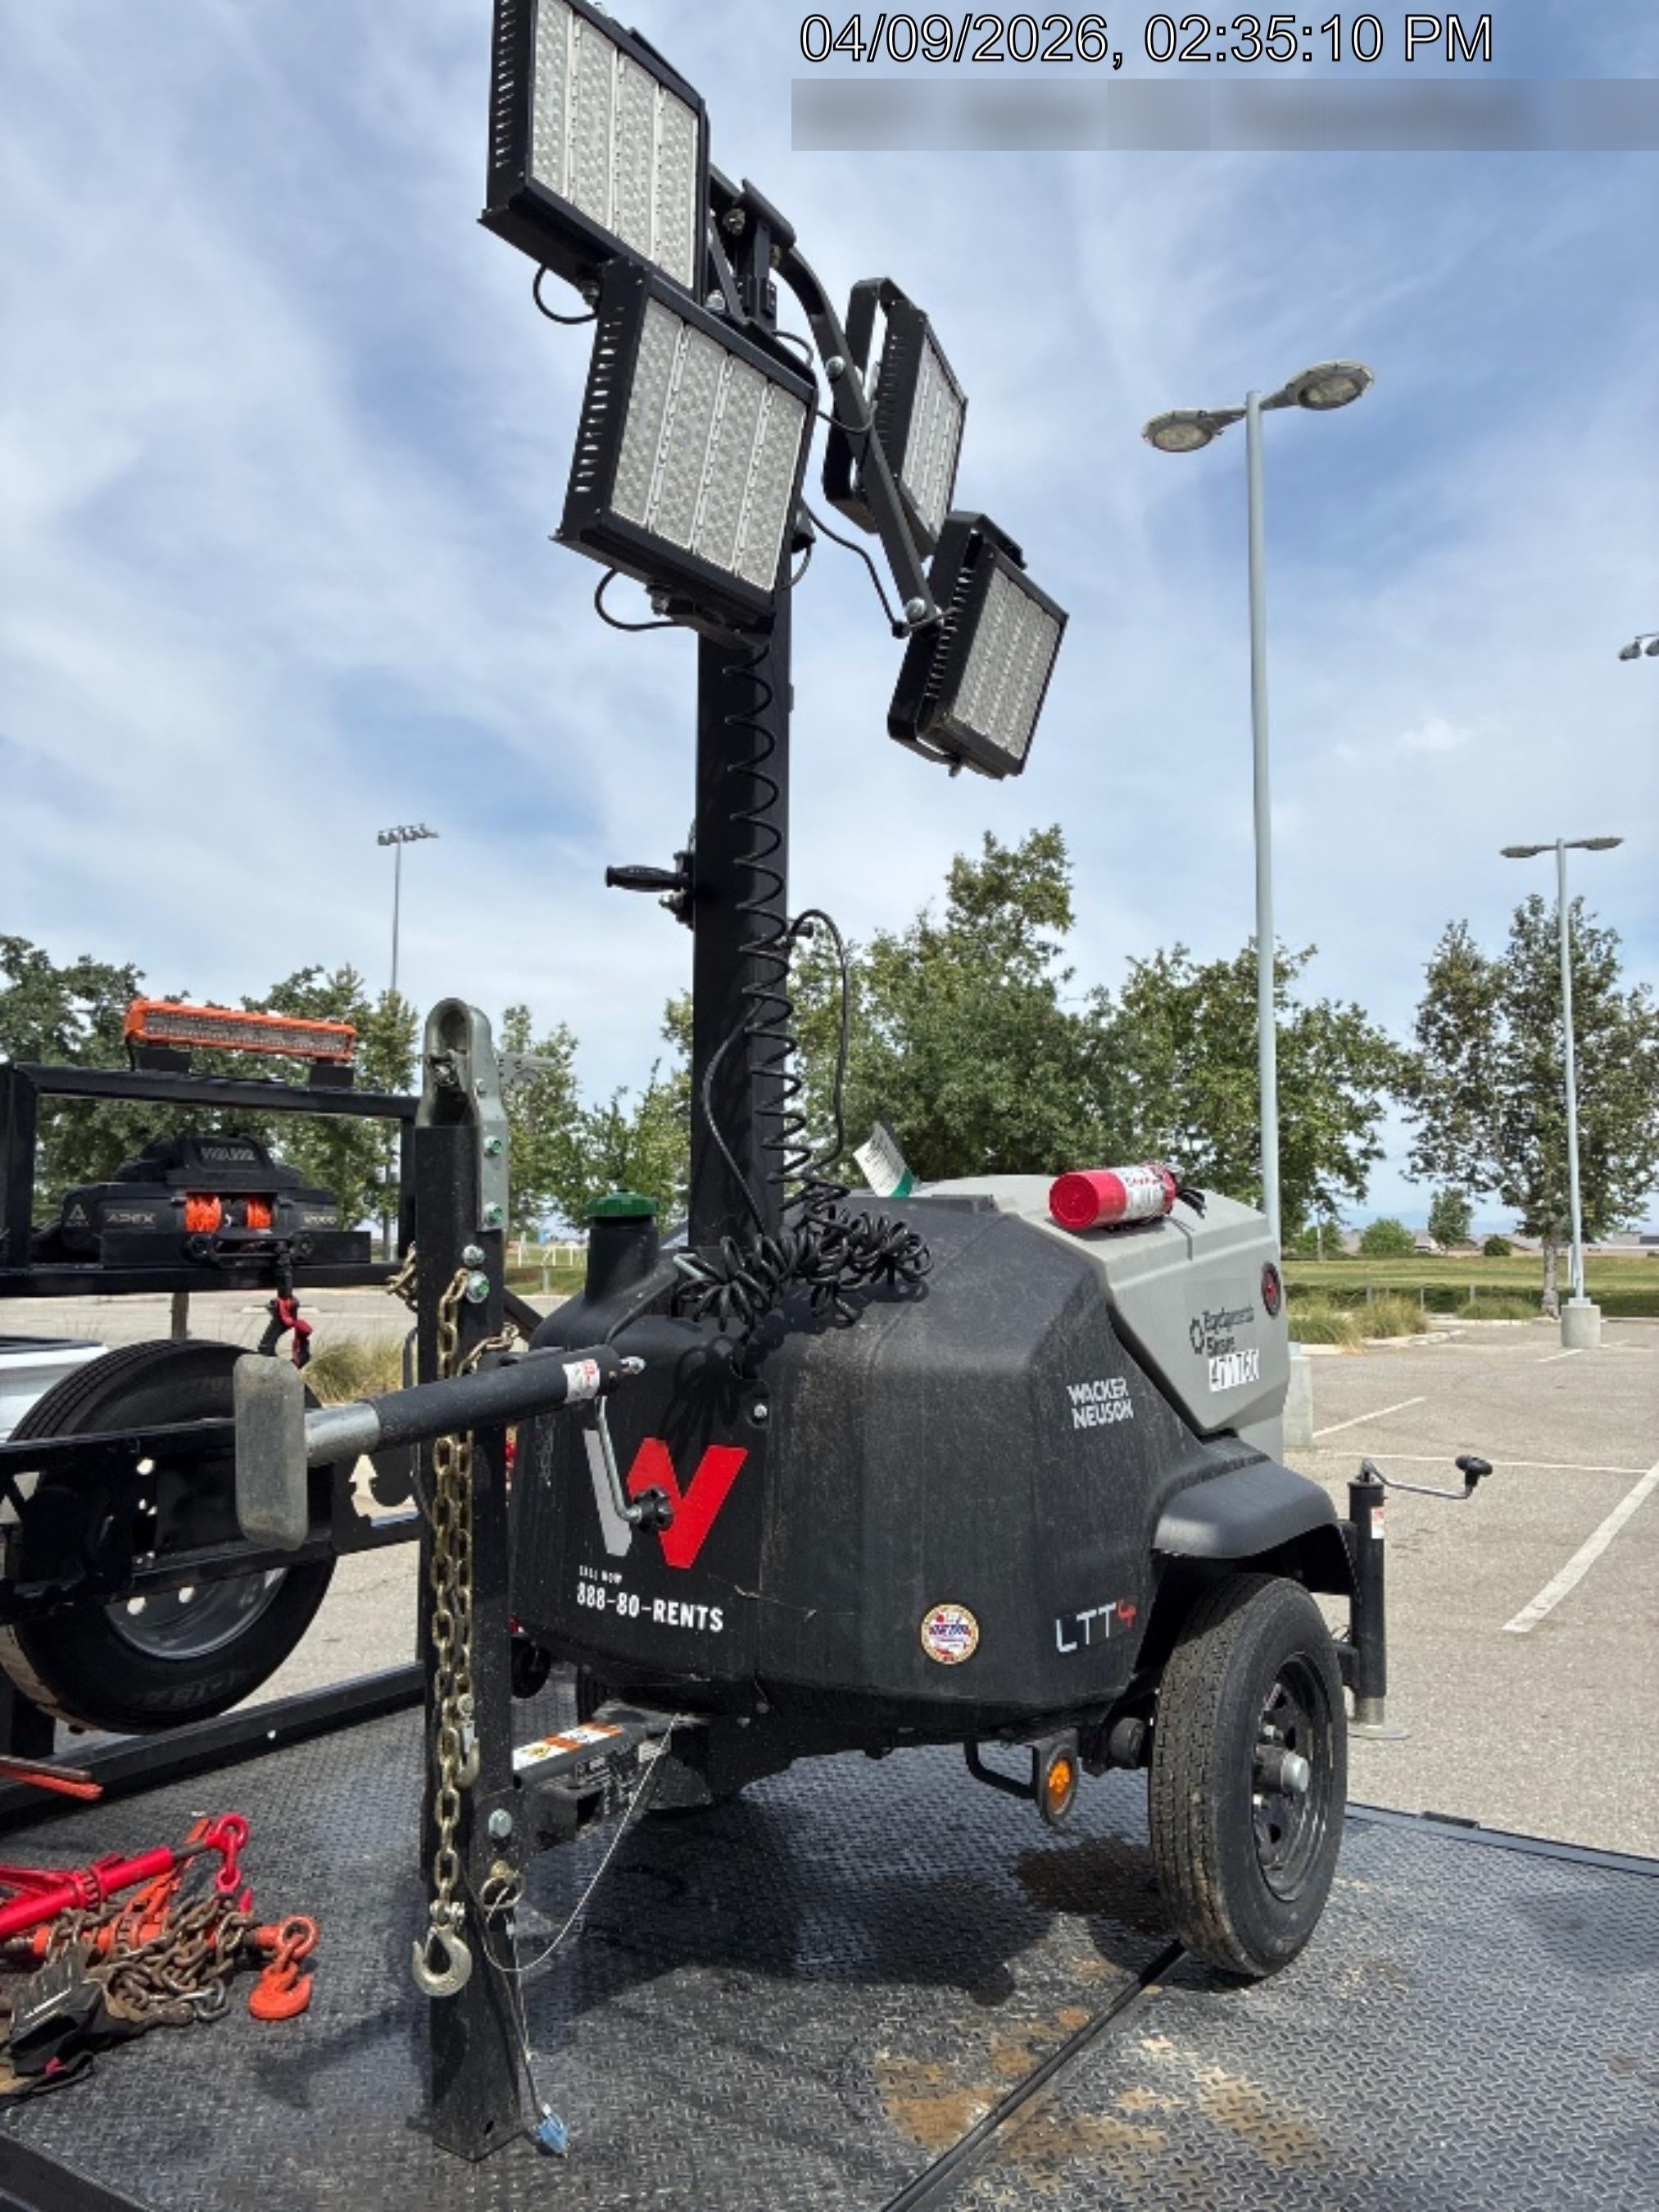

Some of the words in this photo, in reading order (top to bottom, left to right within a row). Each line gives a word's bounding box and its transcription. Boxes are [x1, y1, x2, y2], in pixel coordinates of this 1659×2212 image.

[1067, 1377, 1129, 1406] WACKER
[1072, 1398, 1134, 1429] NEUSON
[577, 1581, 723, 1632] 888-80-RENTS
